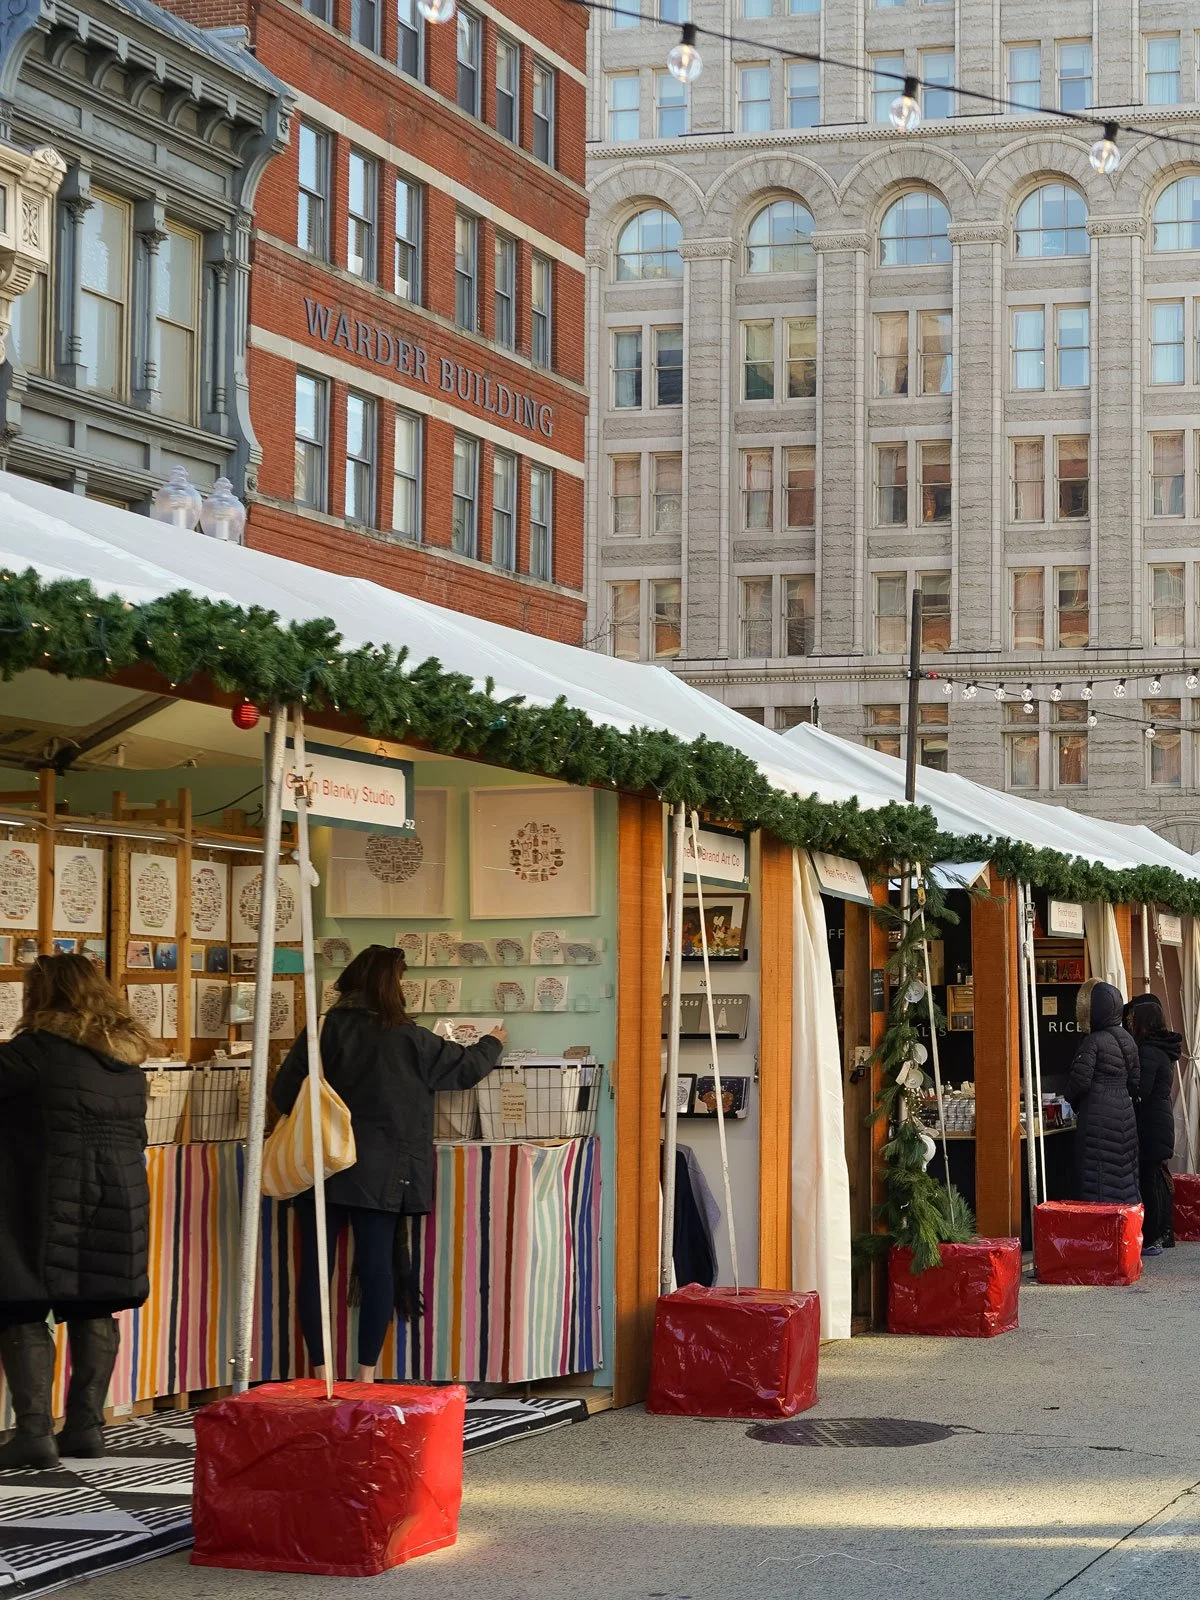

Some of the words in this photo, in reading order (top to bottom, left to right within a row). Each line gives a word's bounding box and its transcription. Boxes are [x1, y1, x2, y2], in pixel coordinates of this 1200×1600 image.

[304, 297, 430, 384] WARDER
[439, 357, 555, 438] BUILDING
[322, 779, 359, 804] Blanky
[362, 786, 396, 807] Studio
[702, 848, 720, 863] Brand
[721, 852, 731, 866] Art
[731, 854, 740, 867] Co
